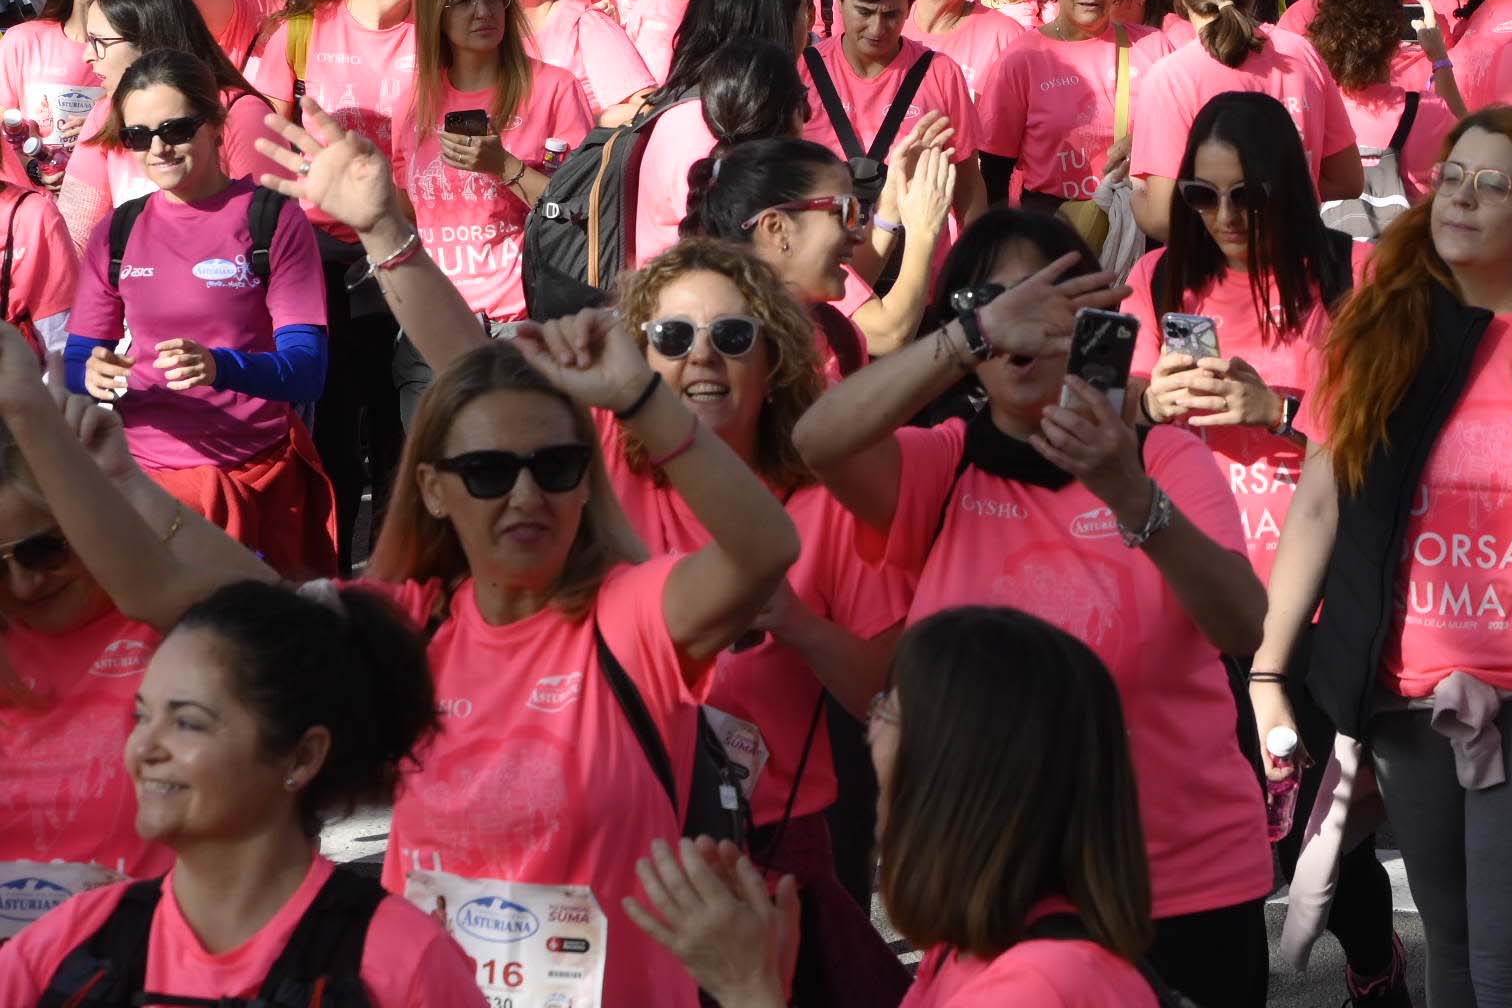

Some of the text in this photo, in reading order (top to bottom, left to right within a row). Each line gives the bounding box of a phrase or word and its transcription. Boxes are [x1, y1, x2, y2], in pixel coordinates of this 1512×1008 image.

[1057, 148, 1087, 173] TU
[1063, 175, 1102, 200] DO
[427, 235, 521, 278] UMA
[461, 911, 533, 939] ASTURIANA
[548, 911, 591, 930] SUMA
[483, 958, 525, 988] 16
